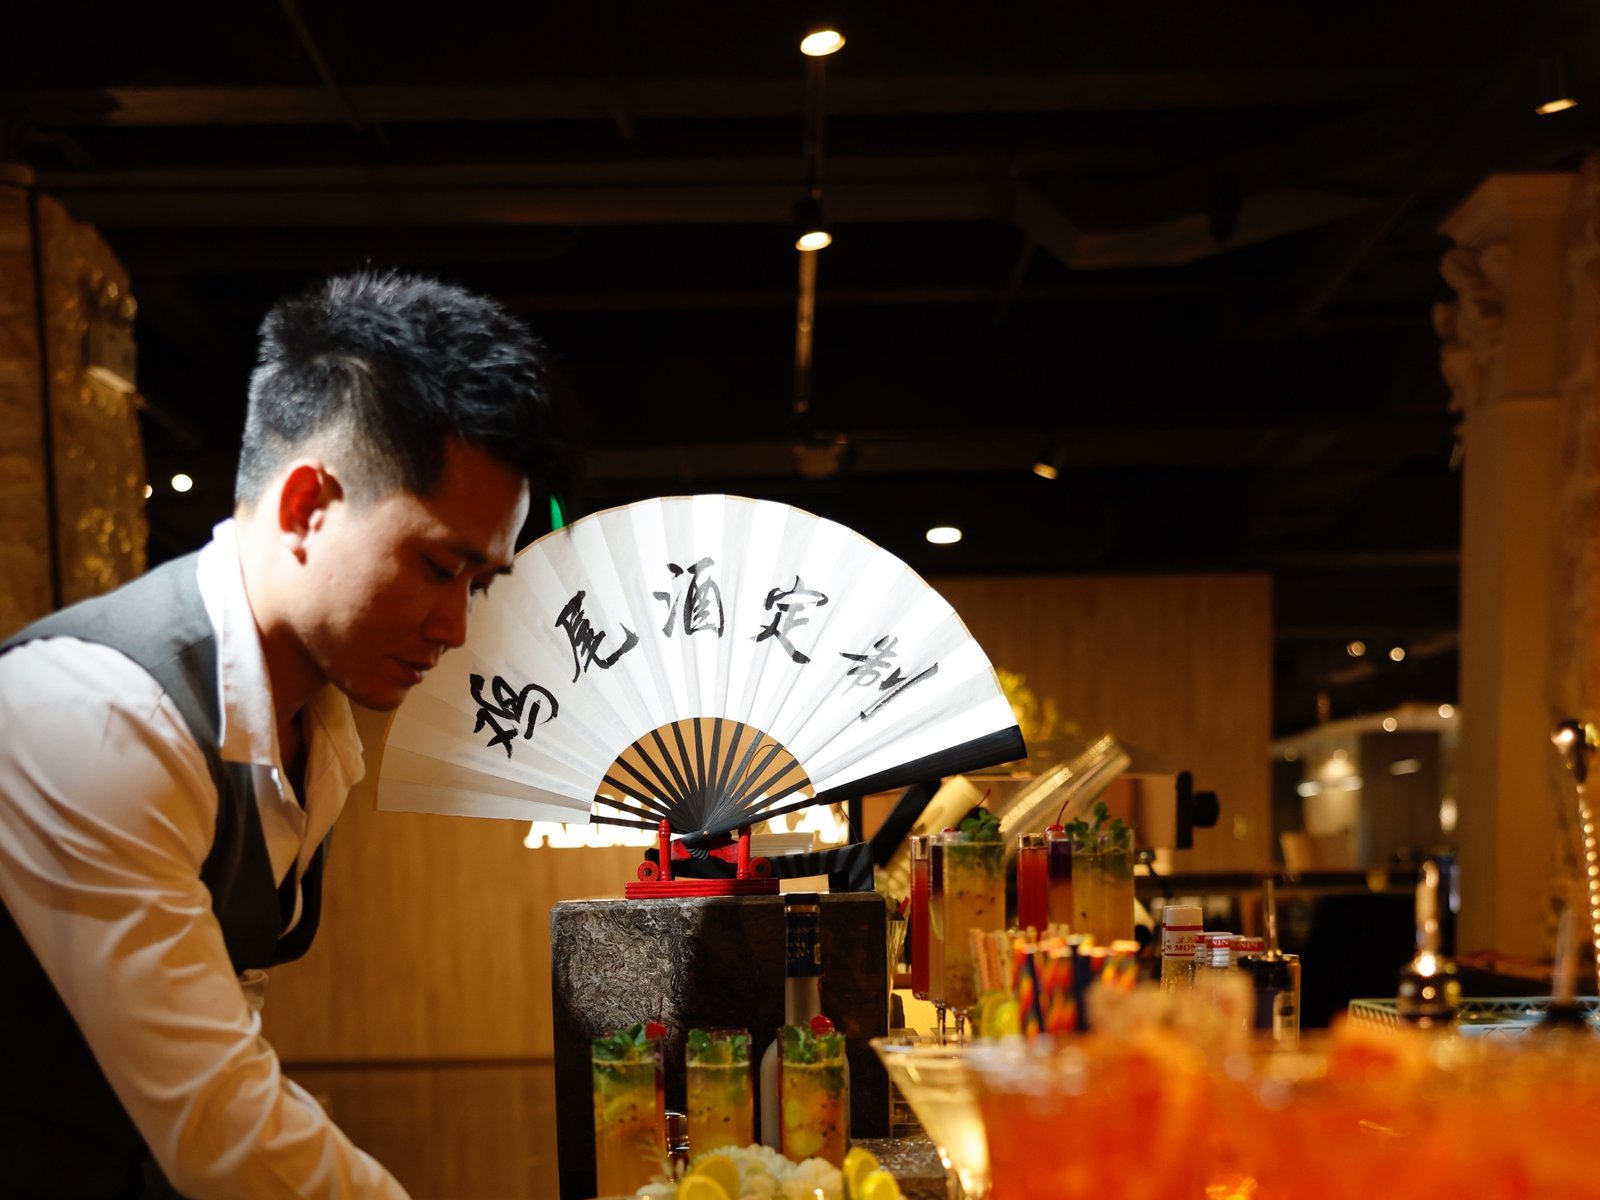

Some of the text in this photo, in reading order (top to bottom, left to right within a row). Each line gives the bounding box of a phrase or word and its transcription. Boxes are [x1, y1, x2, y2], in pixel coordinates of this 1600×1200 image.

[469, 556, 940, 759] 鸡尾酒定制
